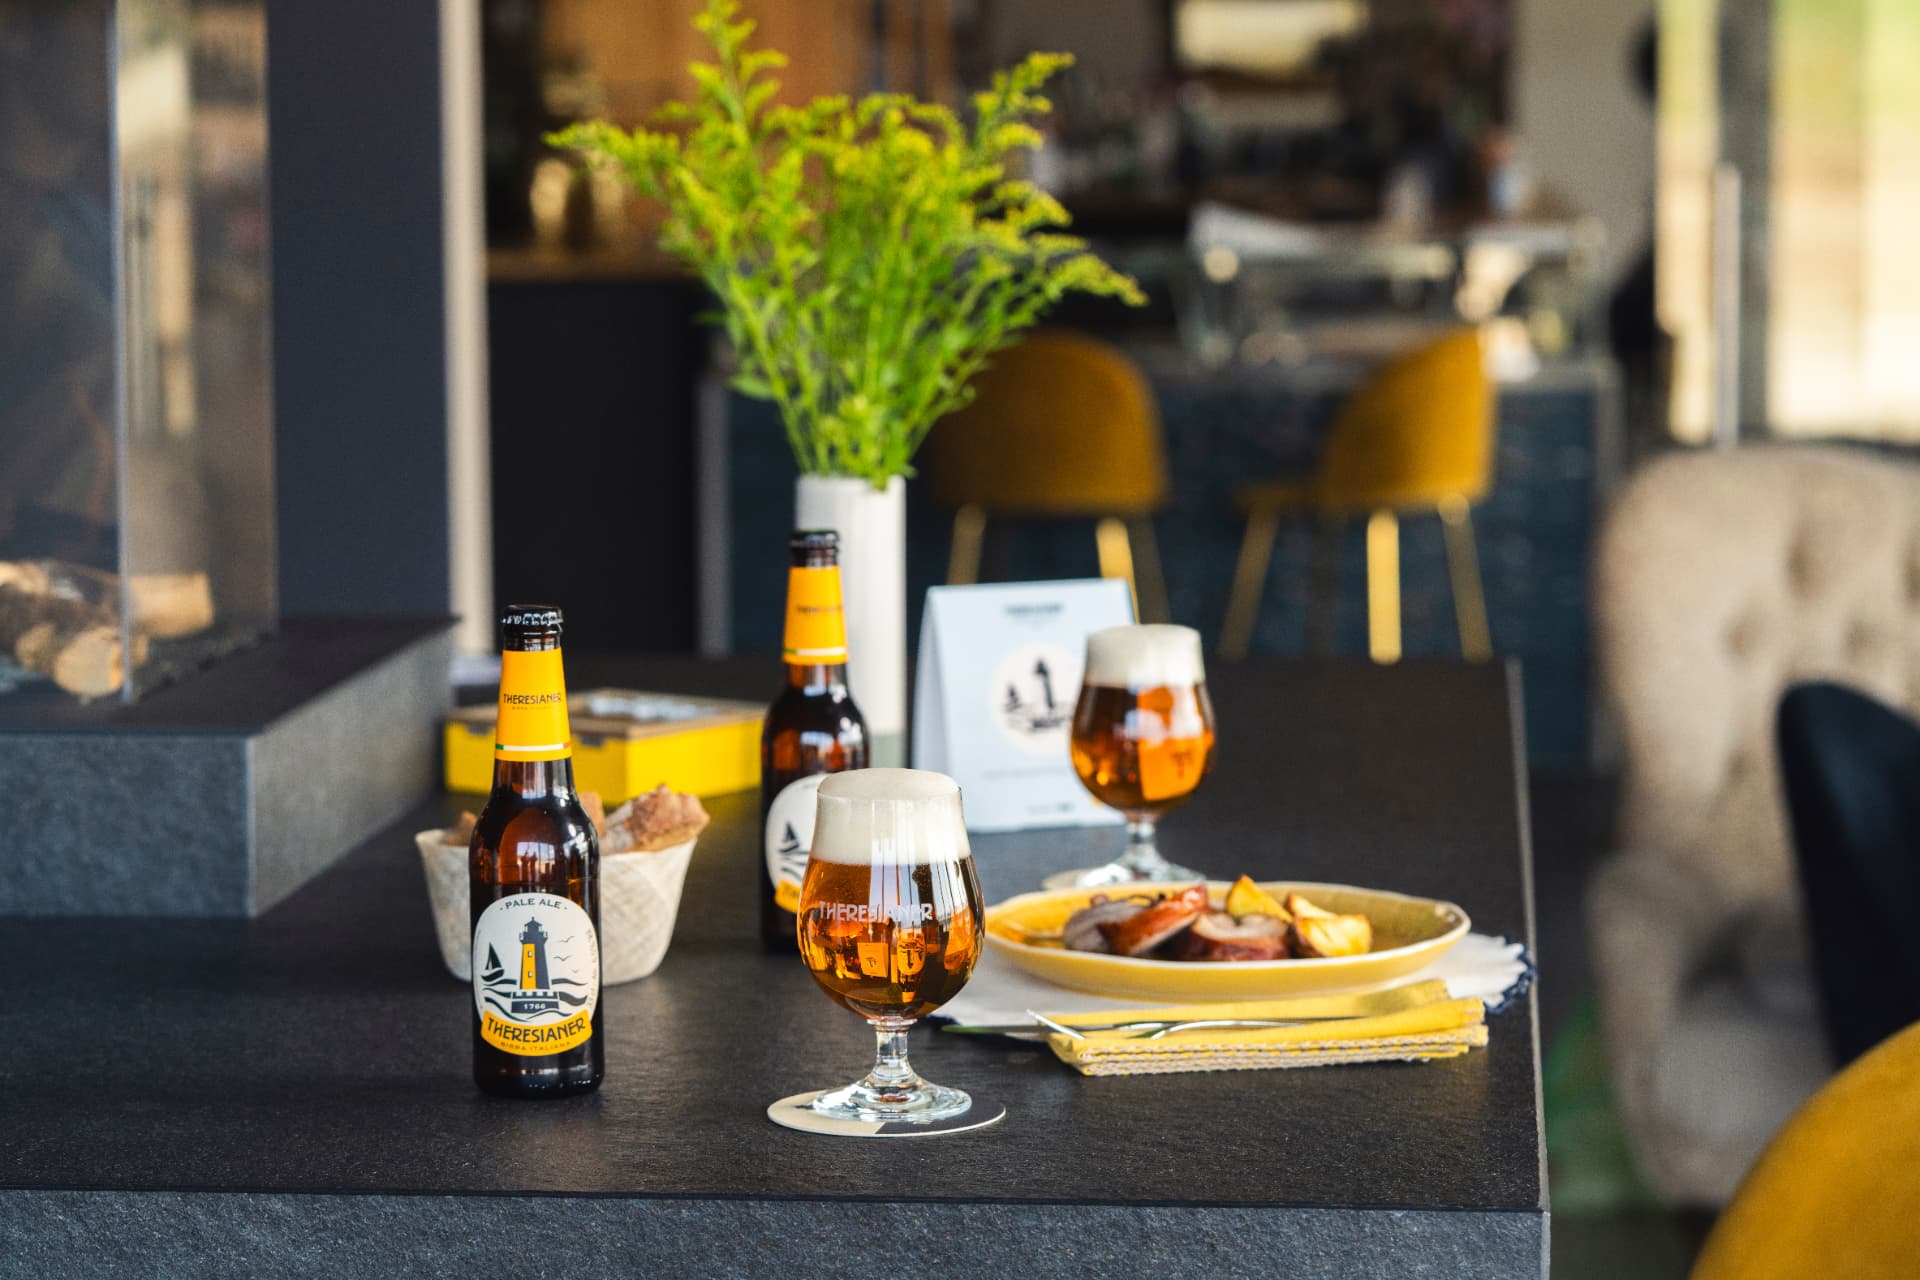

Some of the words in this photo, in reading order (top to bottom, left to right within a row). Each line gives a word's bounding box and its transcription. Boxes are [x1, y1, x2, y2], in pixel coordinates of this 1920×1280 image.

[503, 693, 561, 704] THERESIANER
[505, 898, 535, 910] PALE
[539, 899, 562, 910] ALE
[487, 1017, 585, 1043] THERESIANER
